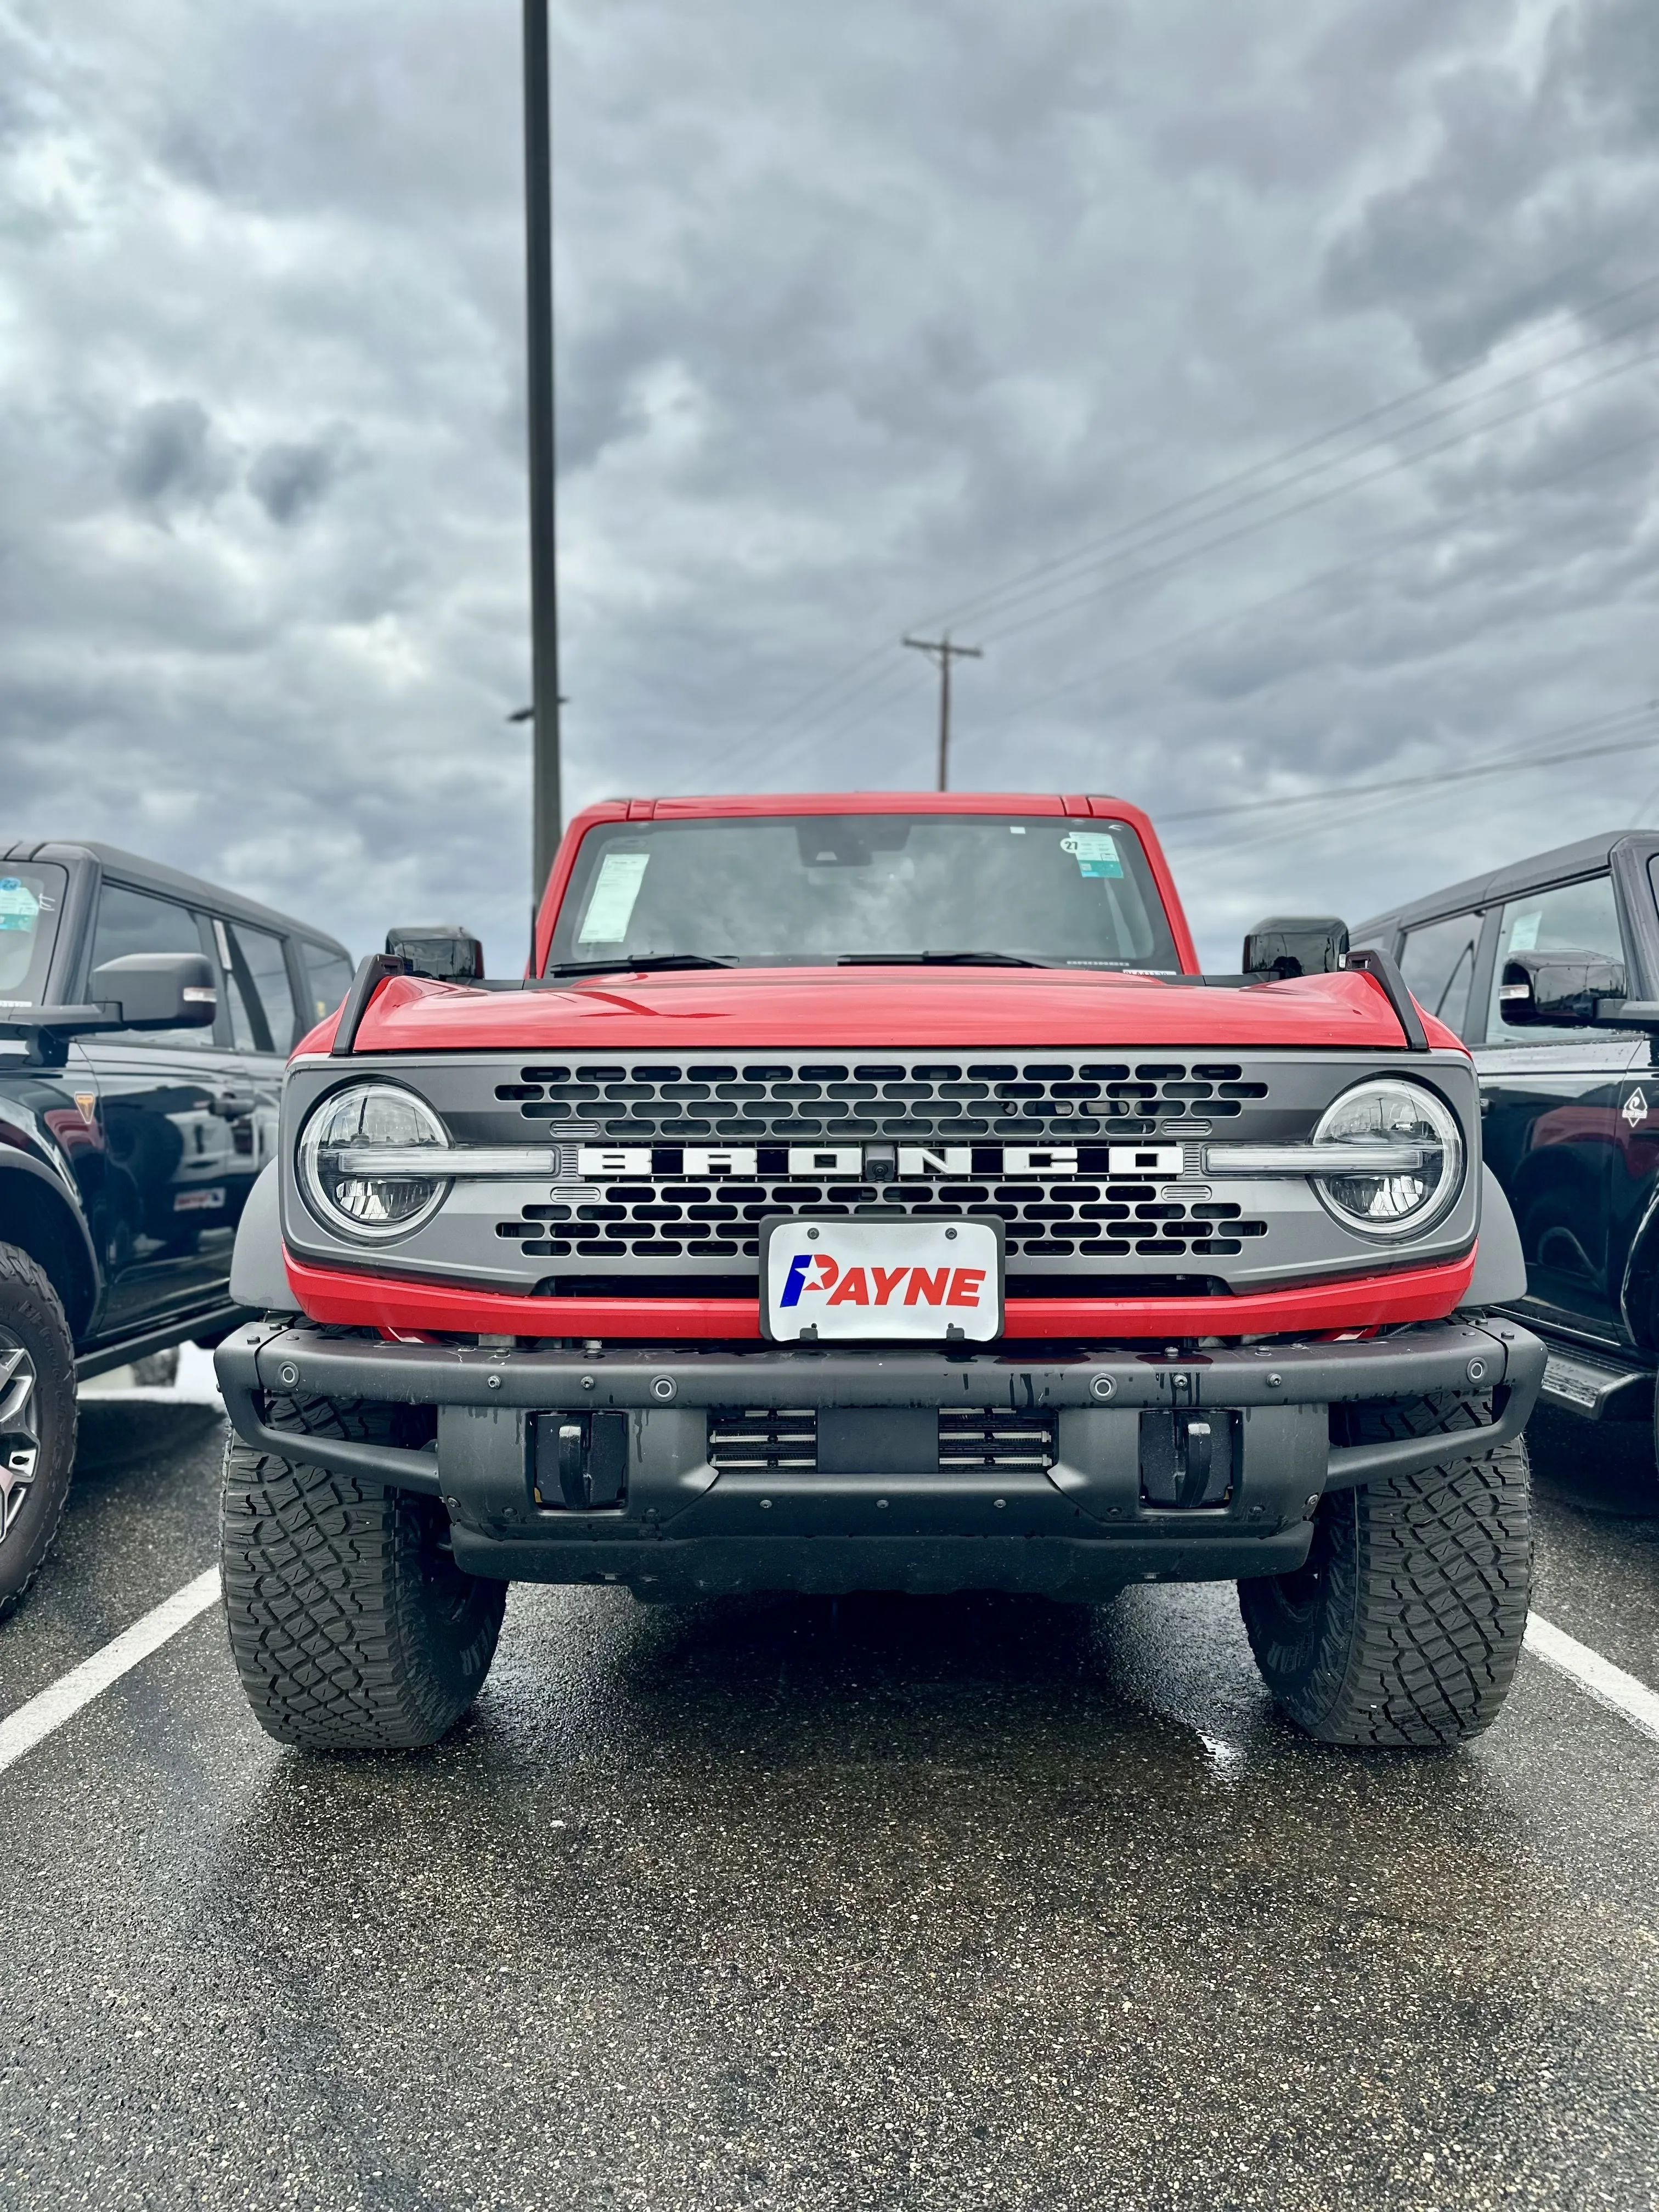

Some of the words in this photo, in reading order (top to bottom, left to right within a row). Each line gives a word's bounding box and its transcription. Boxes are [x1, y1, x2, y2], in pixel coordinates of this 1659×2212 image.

[1064, 841, 1078, 850] 27
[578, 1147, 1184, 1176] BRONCO
[780, 1254, 986, 1308] PAYNE
